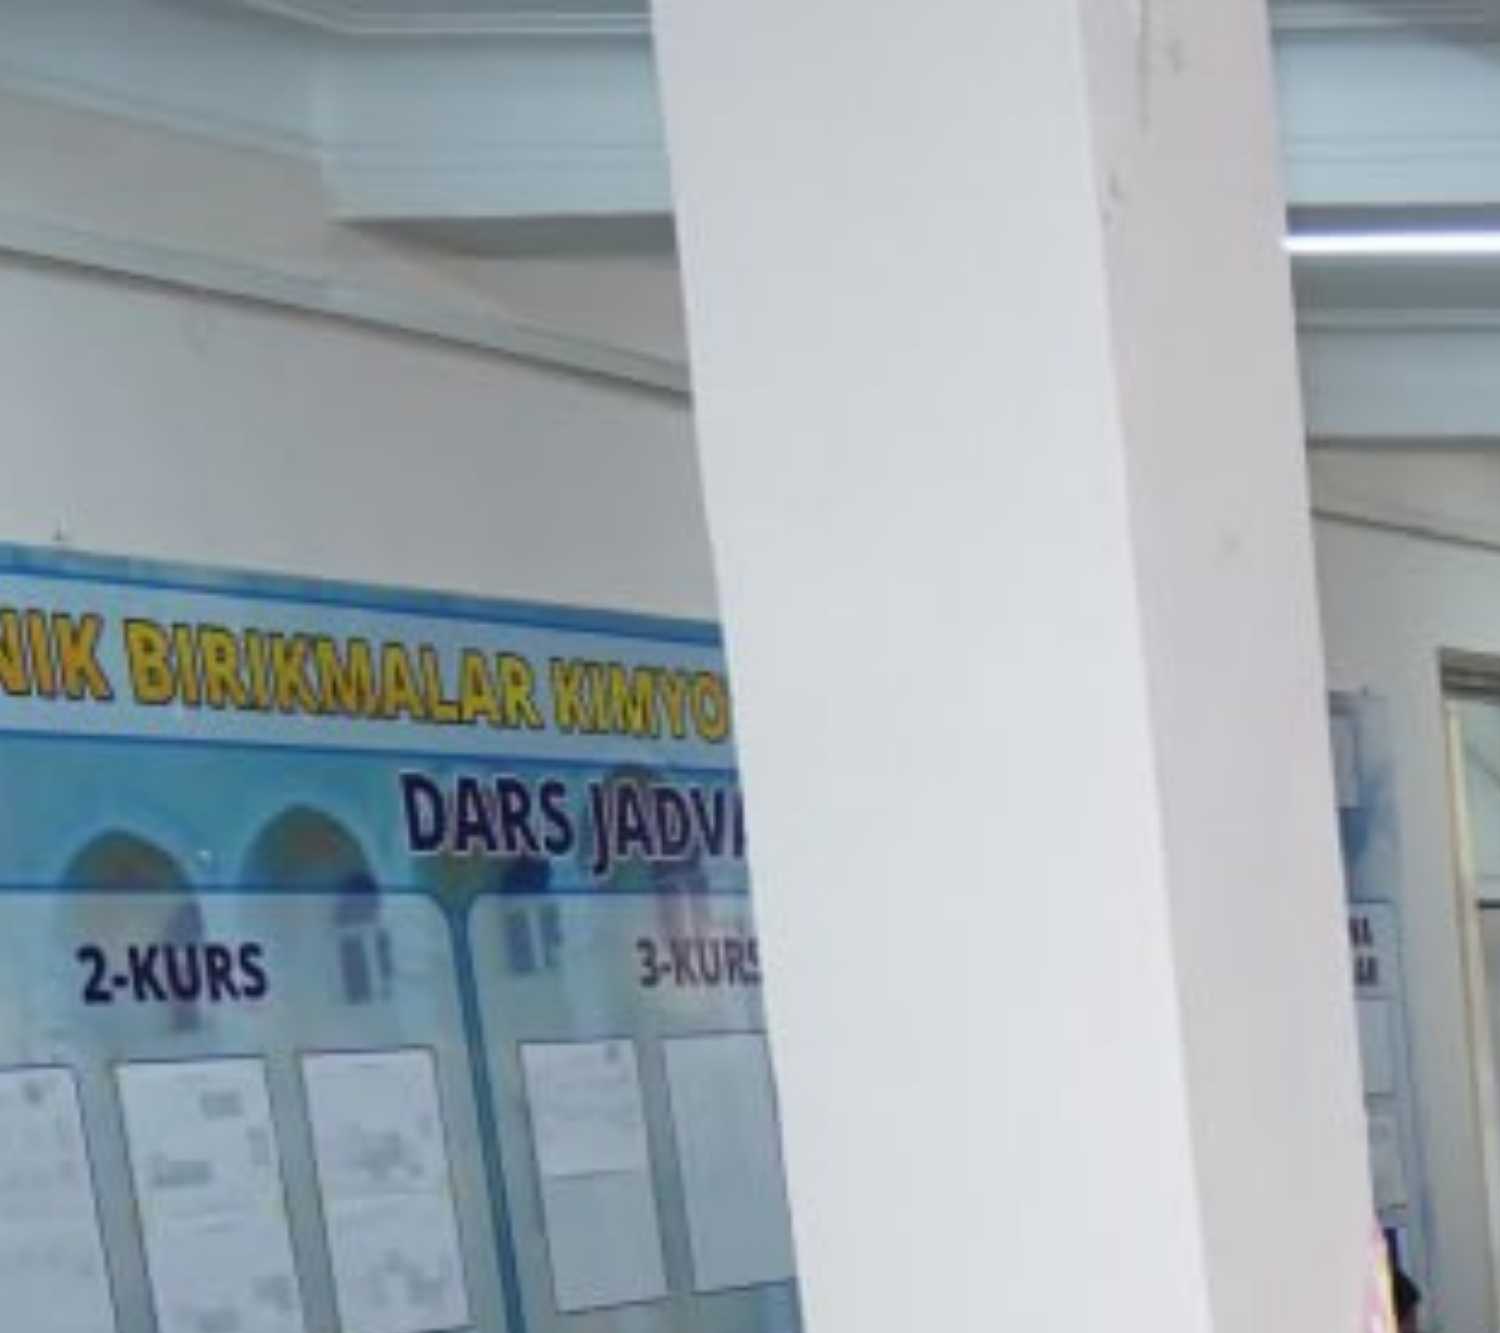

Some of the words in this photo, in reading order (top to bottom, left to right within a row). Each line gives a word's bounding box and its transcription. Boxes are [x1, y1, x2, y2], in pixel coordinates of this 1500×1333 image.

[123, 617, 545, 731] BIRIKMALAR
[551, 655, 734, 743] KIMYO
[400, 770, 575, 856] DARS
[588, 780, 745, 875] JADV
[76, 941, 268, 1004] 2-KURS
